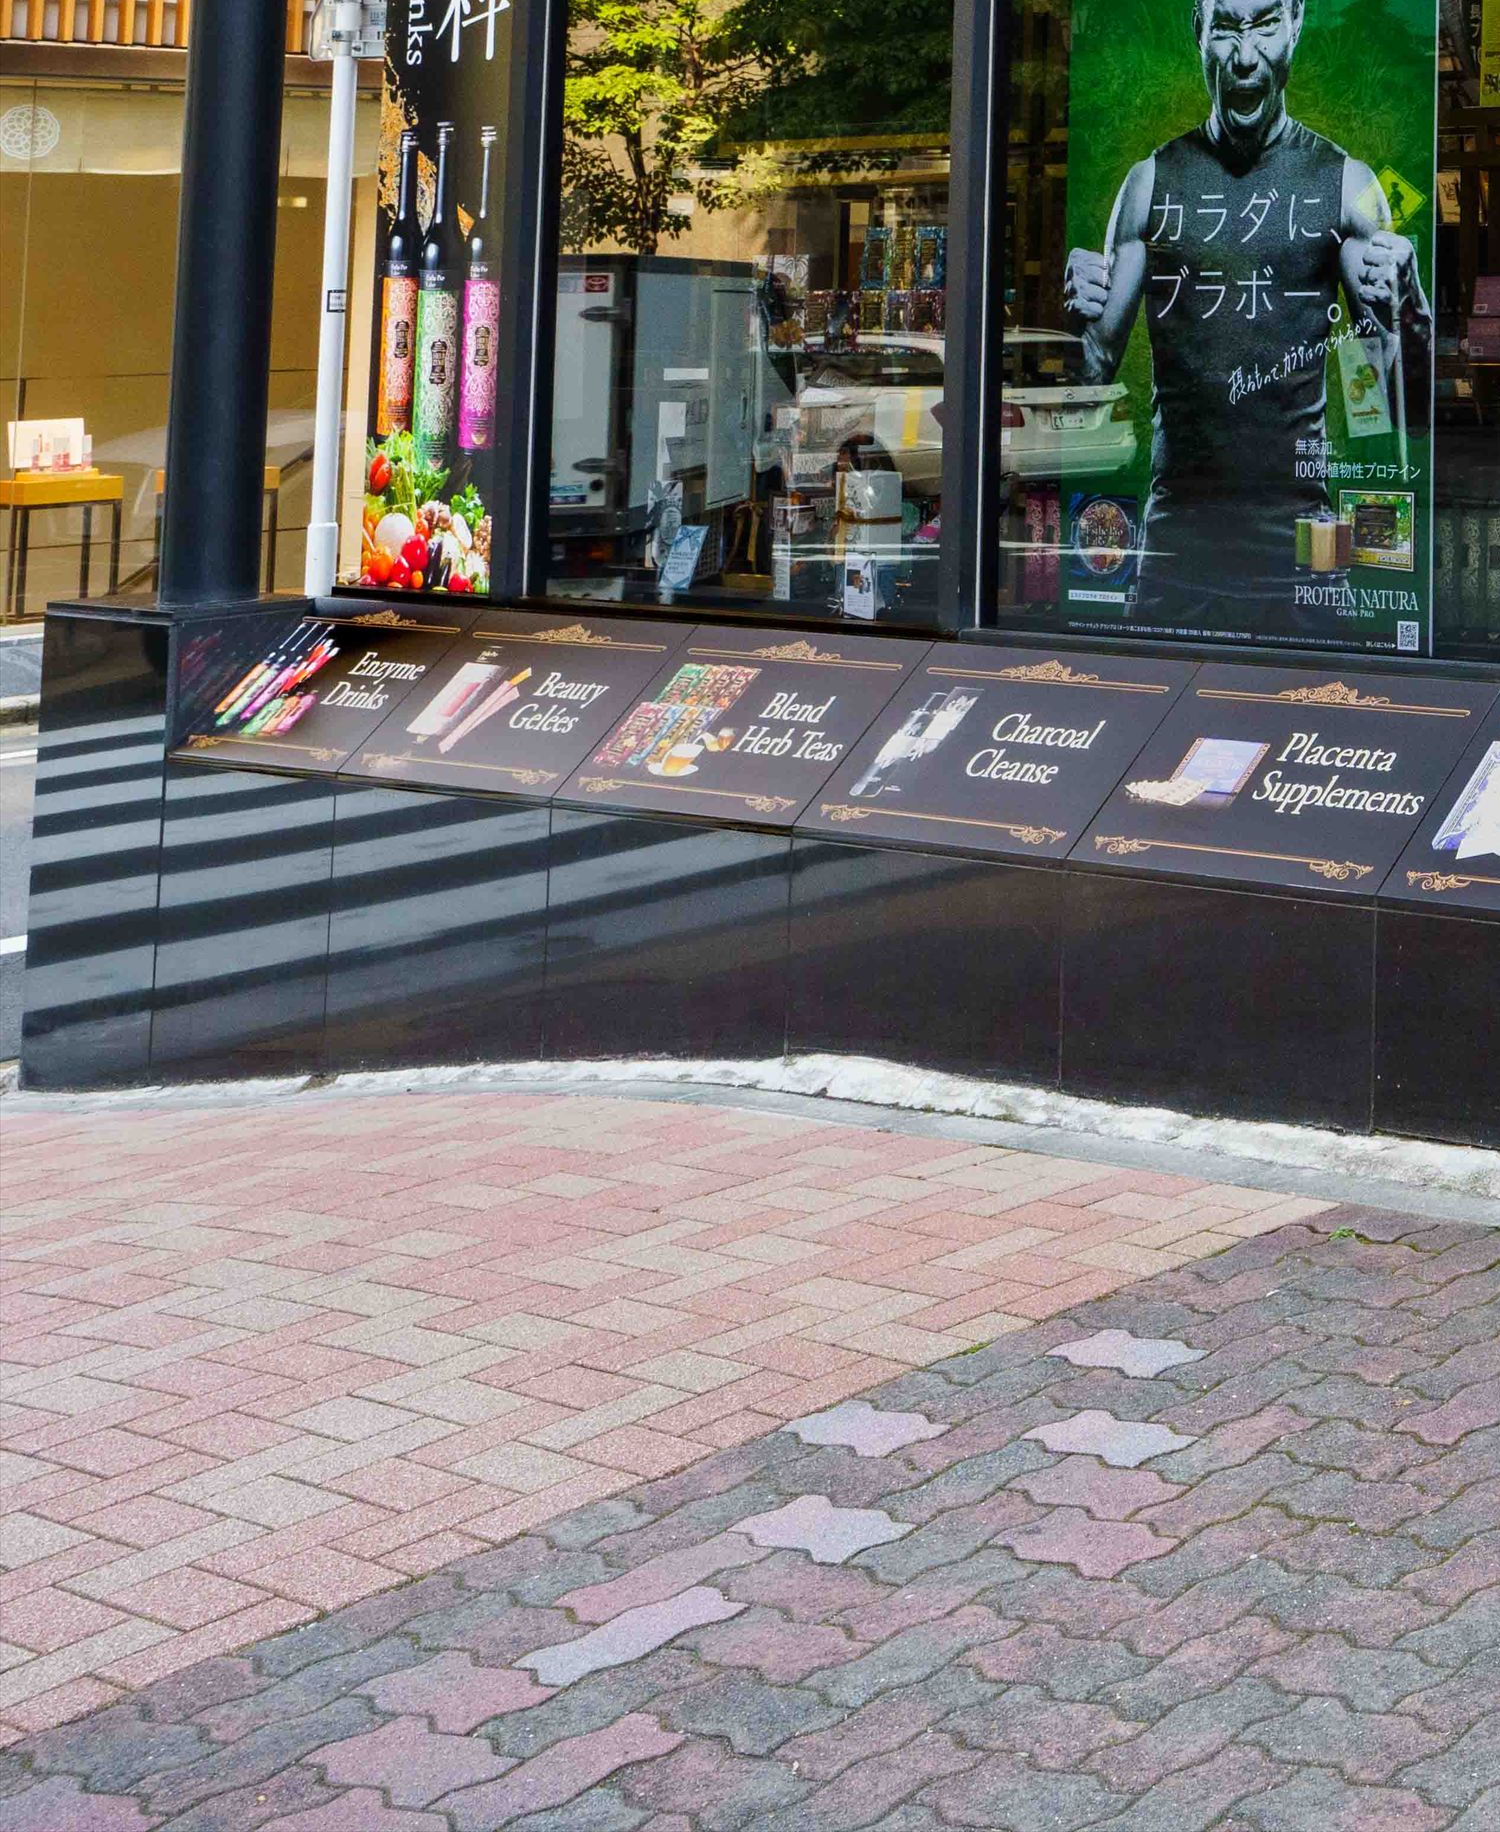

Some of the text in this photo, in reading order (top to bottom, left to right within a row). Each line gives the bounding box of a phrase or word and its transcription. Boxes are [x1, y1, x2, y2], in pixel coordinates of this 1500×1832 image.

[1151, 188, 1342, 244] カラダに、
[1151, 265, 1342, 323] ブラボー。
[1294, 585, 1420, 611] PROTEIN NATURA
[347, 649, 427, 688] Enzyme
[320, 681, 392, 712] Drinks
[532, 671, 610, 707] Beauty
[758, 690, 836, 726] Blend
[508, 702, 581, 737] Gelées
[991, 713, 1107, 751] Charcoal
[730, 722, 845, 764] Herb Teas
[1276, 732, 1399, 774] Placenta
[965, 747, 1060, 786] Cleanse
[1252, 769, 1426, 818] Supplements
